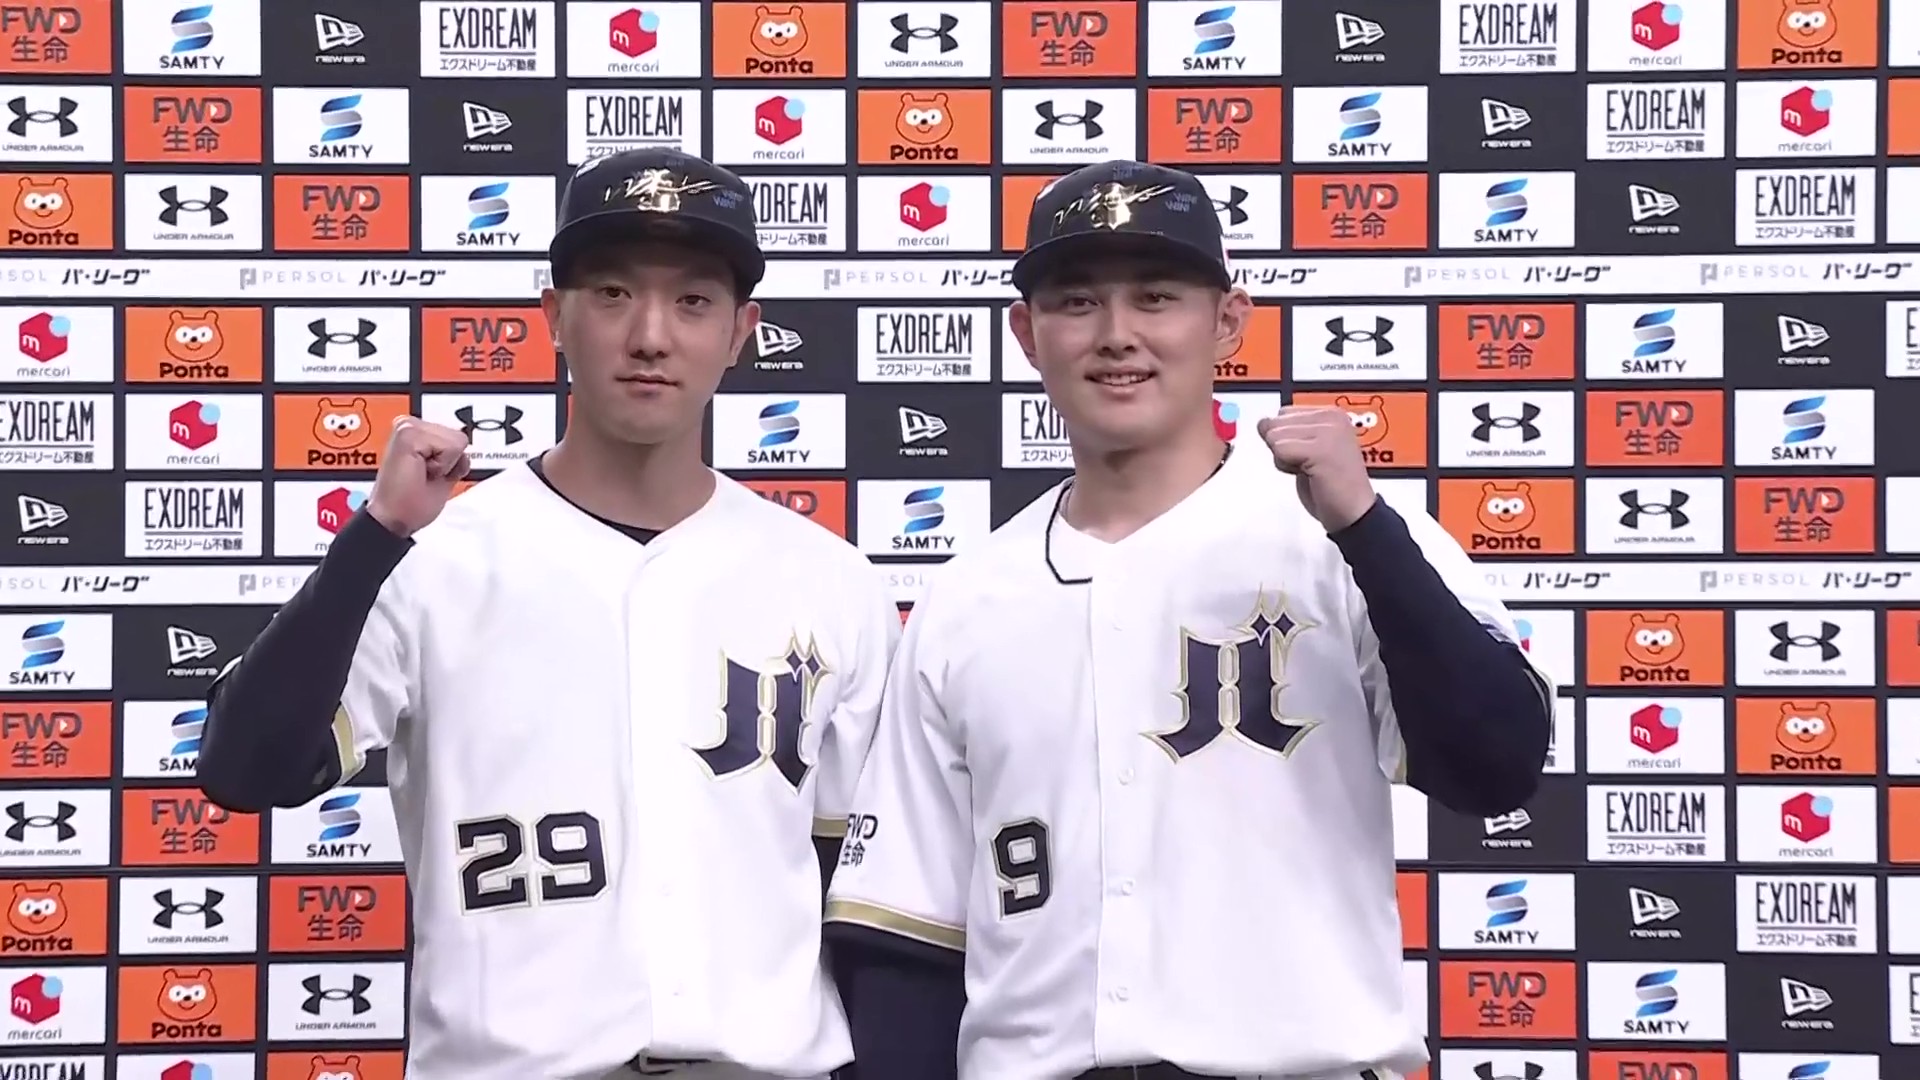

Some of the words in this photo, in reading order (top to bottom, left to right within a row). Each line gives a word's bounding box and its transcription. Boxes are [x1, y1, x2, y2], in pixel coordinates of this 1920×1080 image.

[1, 6, 81, 34] FWD
[440, 8, 536, 49] EXDREAM
[1032, 11, 1108, 37] FWD
[1460, 3, 1557, 45] EXDREAM
[11, 36, 69, 63] 生命
[160, 55, 224, 69] SAMTY
[1041, 40, 1095, 66] 生命
[1629, 53, 1682, 65] mercari
[1772, 47, 1843, 65] Ponta
[607, 63, 660, 74] mercari
[745, 57, 813, 75] Ponta
[1183, 56, 1245, 70] SAMTY
[154, 97, 232, 124] FWD
[586, 96, 682, 136] EXDREAM
[1176, 98, 1253, 124] FWD
[1607, 89, 1705, 131] EXDREAM
[163, 123, 219, 152] 生命
[1186, 126, 1240, 152] 生命
[1328, 143, 1391, 156] SAMTY
[1778, 139, 1832, 151] mercari
[309, 145, 372, 157] SAMTY
[753, 148, 804, 159] mercari
[890, 145, 958, 161] Ponta
[303, 185, 380, 212] FWD
[1322, 184, 1399, 210] FWD
[1756, 175, 1855, 217] EXDREAM
[7, 229, 79, 246] Ponta
[312, 214, 368, 240] 生命
[1331, 212, 1386, 238] 生命
[1475, 229, 1538, 242] SAMTY
[457, 233, 519, 245] SAMTY
[898, 237, 949, 246] mercari
[450, 317, 528, 344] FWD
[877, 314, 972, 354] EXDREAM
[1468, 314, 1545, 341] FWD
[460, 346, 515, 372] 生命
[1477, 342, 1533, 369] 生命
[1622, 359, 1686, 373] SAMTY
[17, 365, 70, 377] mercari
[159, 362, 229, 379] Ponta
[1616, 401, 1693, 427] FWD
[1625, 426, 1682, 455] 生命
[1772, 447, 1836, 460] SAMTY
[167, 452, 219, 464] mercari
[308, 448, 379, 466] Ponta
[748, 449, 809, 463] SAMTY
[145, 488, 243, 528] EXDREAM
[1765, 487, 1844, 514] FWD
[1775, 512, 1832, 542] 生命
[892, 534, 954, 549] SAMTY
[1472, 532, 1541, 549] Ponta
[10, 670, 75, 684] SAMTY
[1619, 666, 1690, 683] Ponta
[2, 712, 82, 742] FWD
[12, 741, 69, 767] 生命
[1628, 756, 1681, 768] mercari
[1770, 753, 1842, 771] Ponta
[153, 796, 230, 824] FWD
[1607, 792, 1705, 834] EXDREAM
[160, 824, 218, 854] 生命
[307, 844, 371, 857] SAMTY
[456, 811, 607, 914] 29
[1779, 848, 1833, 857] mercari
[991, 817, 1053, 921] 9
[298, 885, 376, 915] FWD
[1756, 882, 1856, 925] EXDREAM
[307, 913, 364, 941] 生命
[1475, 930, 1538, 943] SAMTY
[0, 935, 73, 953] Ponta
[1469, 971, 1546, 998] FWD
[1479, 1000, 1535, 1027] 生命
[1624, 1020, 1688, 1033] SAMTY
[8, 1027, 62, 1040] mercari
[152, 1021, 221, 1039] Ponta
